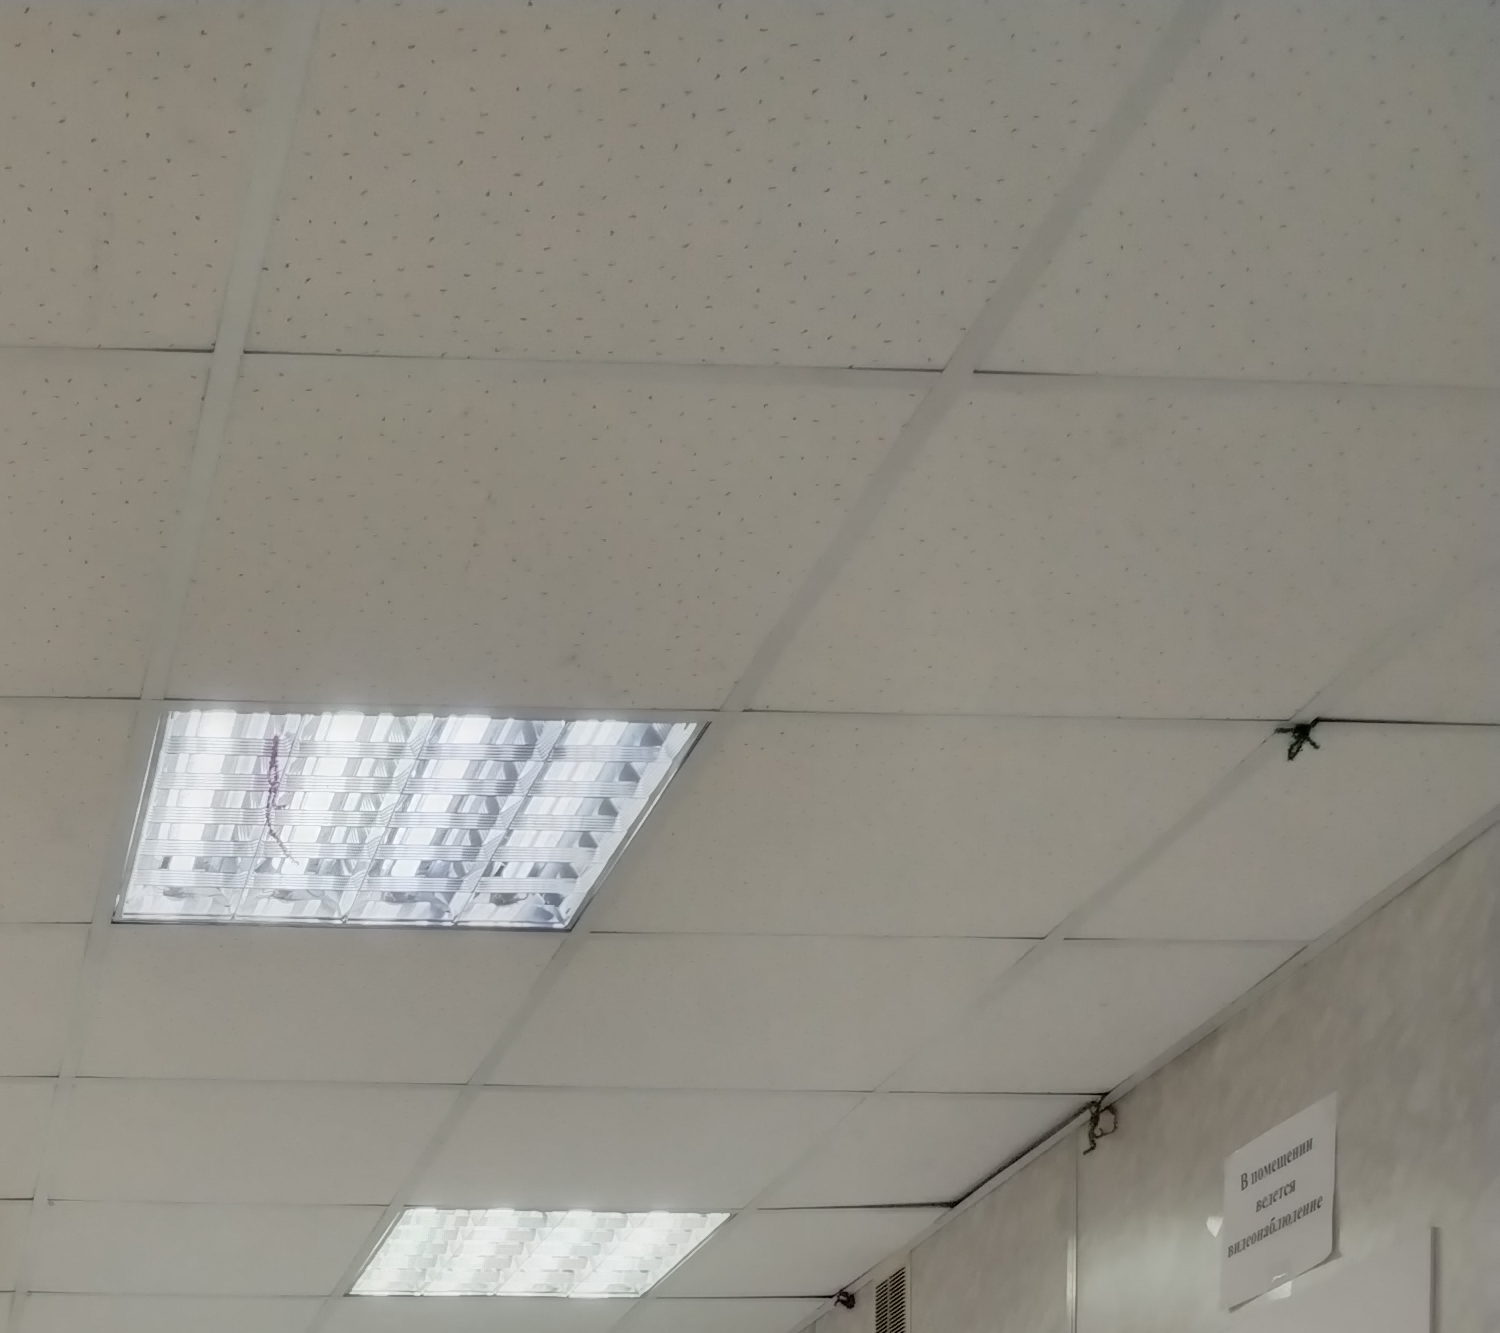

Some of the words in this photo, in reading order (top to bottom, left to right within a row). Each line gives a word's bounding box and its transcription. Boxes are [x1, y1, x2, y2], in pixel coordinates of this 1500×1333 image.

[1240, 1172, 1249, 1191] В
[1251, 1138, 1313, 1185] помещении
[1255, 1180, 1296, 1213] ведется
[1227, 1195, 1323, 1258] видеонаблюдение
